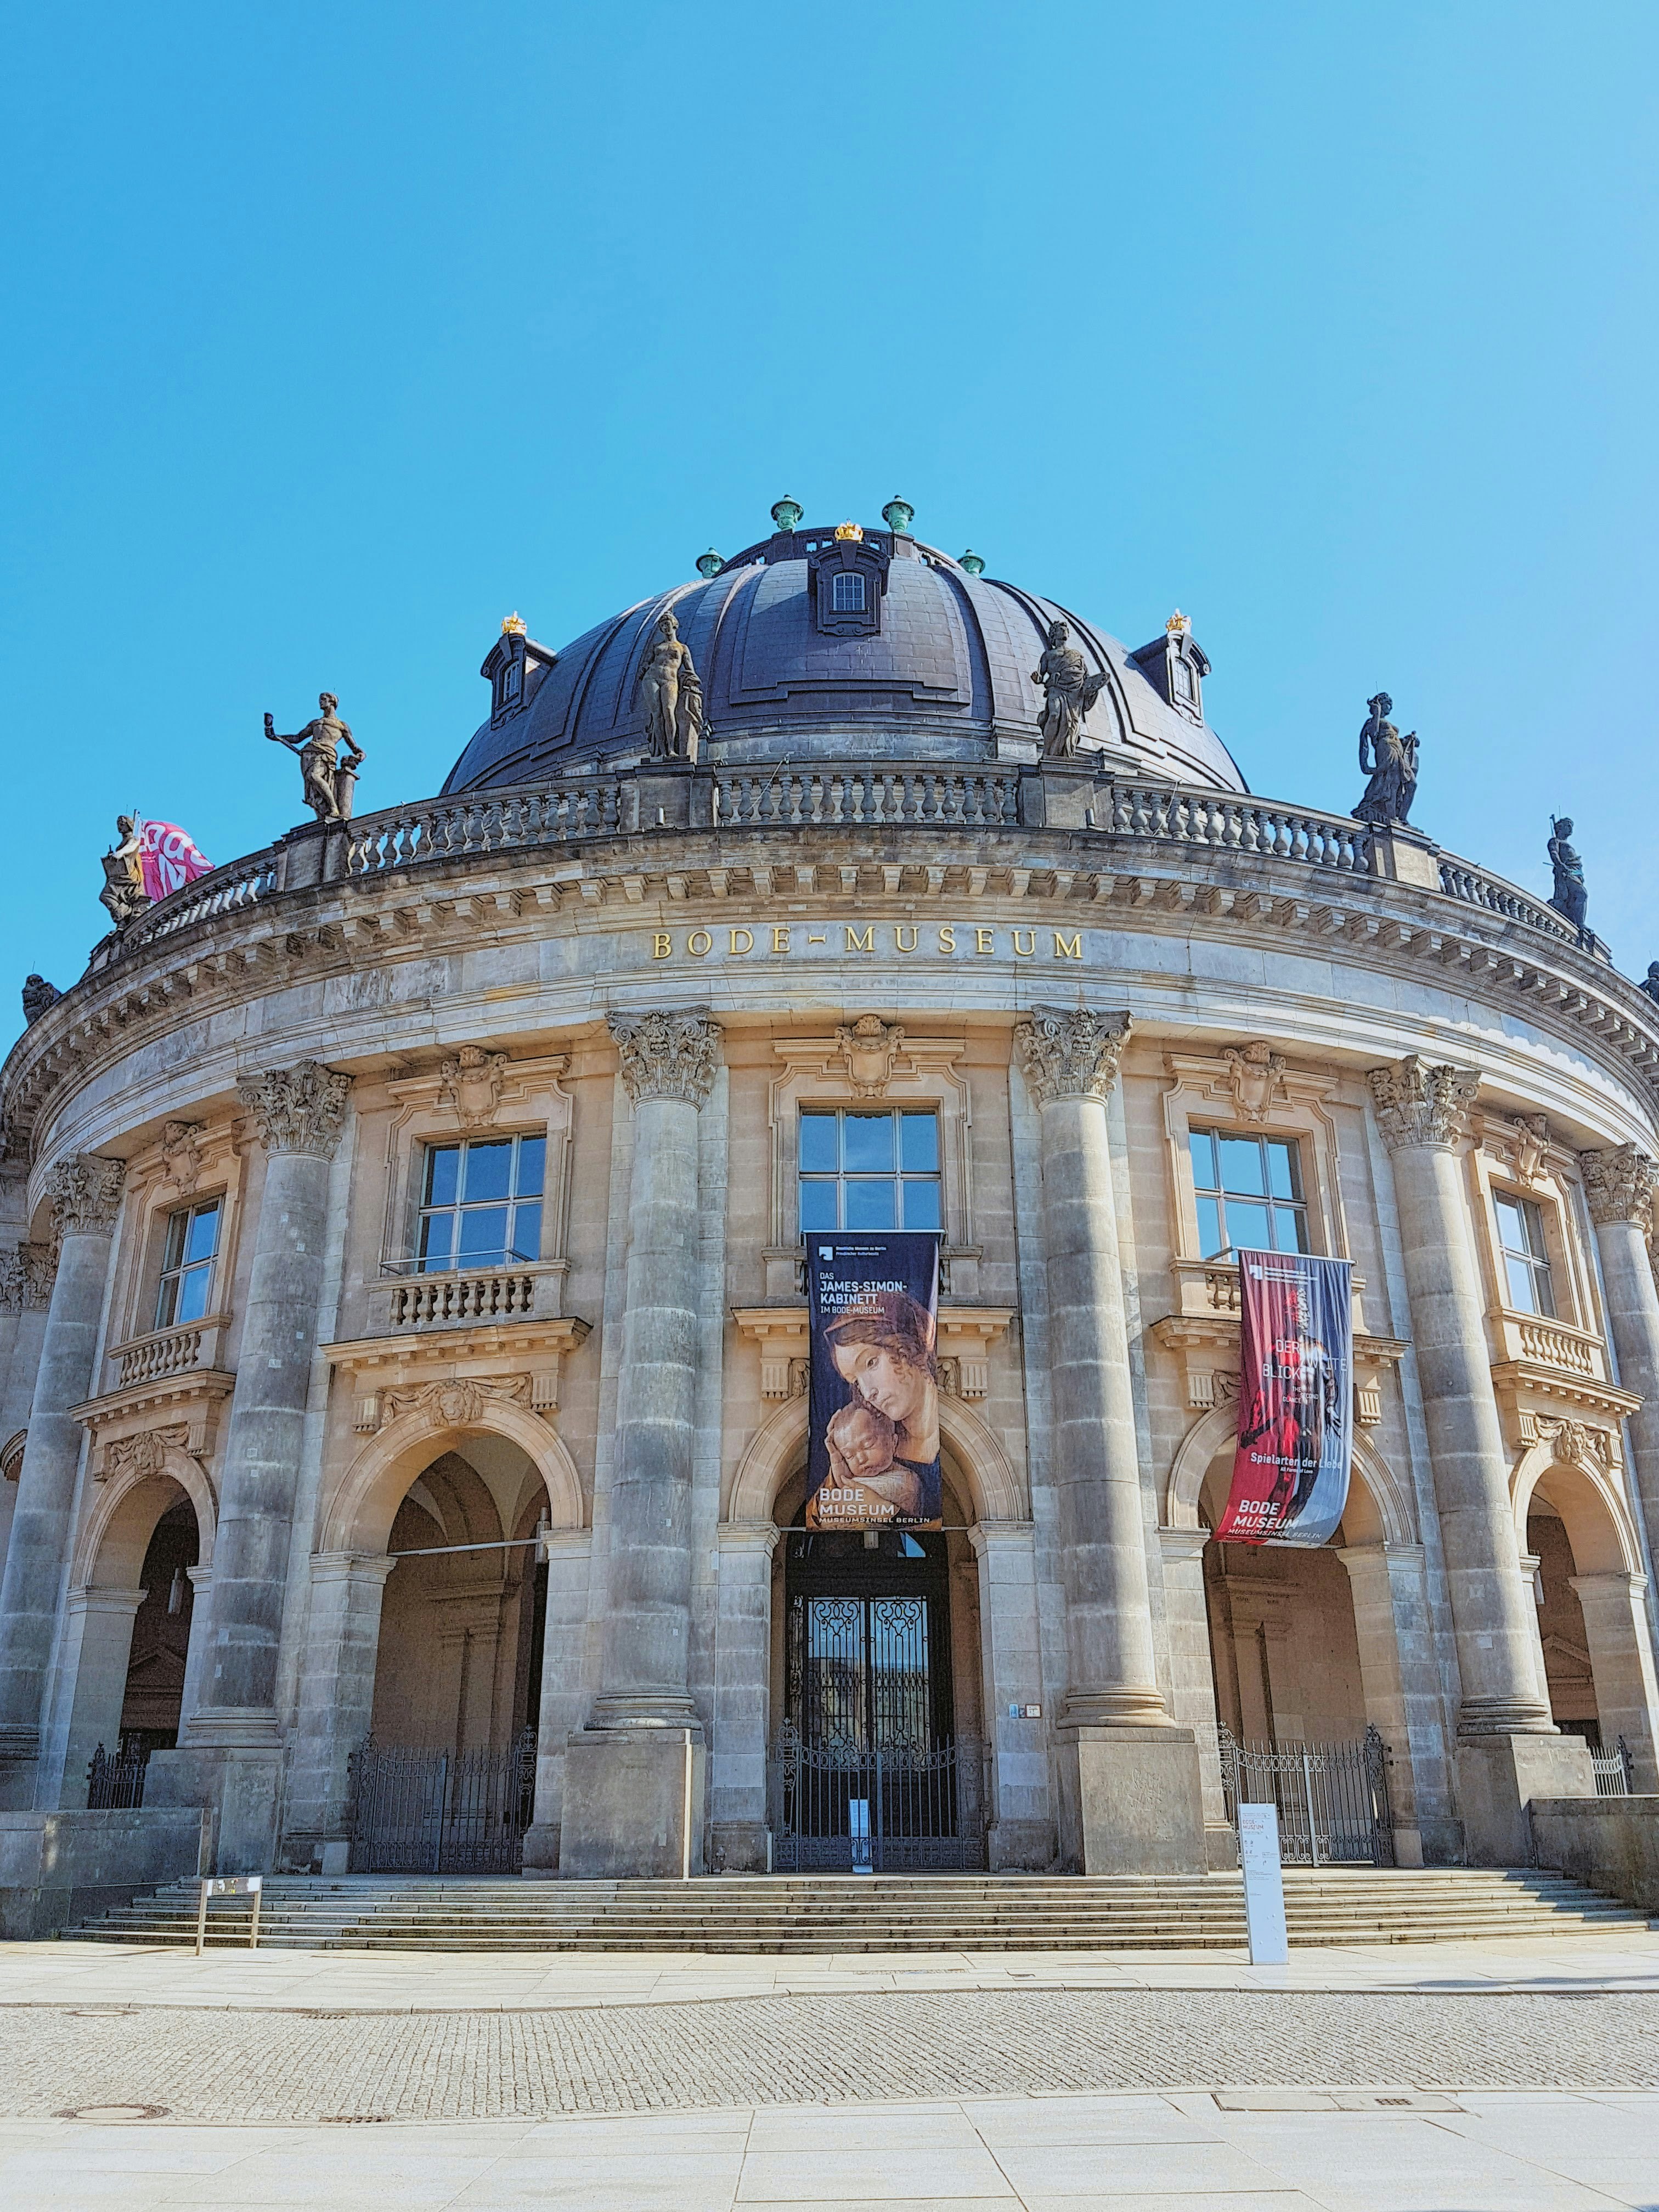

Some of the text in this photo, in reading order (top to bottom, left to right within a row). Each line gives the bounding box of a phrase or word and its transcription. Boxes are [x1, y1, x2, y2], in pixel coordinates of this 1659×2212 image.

[652, 926, 1084, 959] BODE-MUSEUM
[820, 1281, 907, 1291] JAMES-SIMON-
[820, 1293, 877, 1304] KABINETT
[1276, 1339, 1300, 1353] DER
[1263, 1363, 1300, 1380] BLICK
[1251, 1452, 1342, 1469] Spielarten der Liebe
[820, 1488, 865, 1502] BODE
[820, 1504, 894, 1515] MUSEUM
[1238, 1499, 1280, 1515] BODE
[1233, 1515, 1299, 1530] MUSEUM
